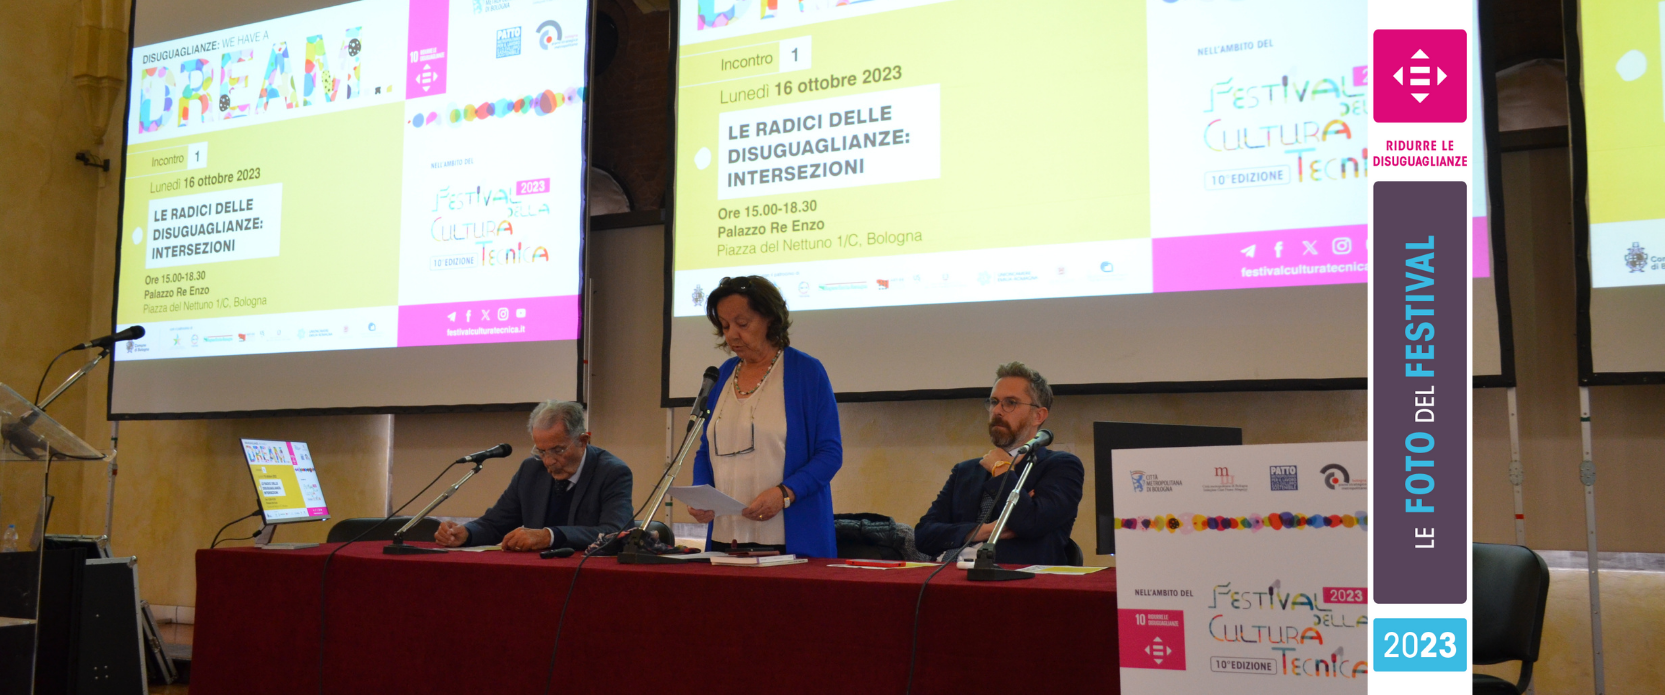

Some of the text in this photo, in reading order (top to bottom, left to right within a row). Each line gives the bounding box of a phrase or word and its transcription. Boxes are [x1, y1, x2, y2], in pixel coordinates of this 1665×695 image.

[497, 28, 520, 40] PATTO
[143, 30, 269, 64] DISUGUAGLIANZE: WE HAVE A
[791, 47, 799, 62] 1
[1197, 39, 1273, 57] NELL'AMBITO DEL
[410, 51, 418, 63] 10
[721, 53, 773, 72] Incontro
[720, 65, 903, 105] Lunedì 16 ottobre 2023
[728, 105, 892, 140] LE RADICI DELLE
[728, 128, 911, 164] DISUGUAGLIANZE:
[151, 154, 185, 167] Incontro
[195, 150, 200, 162] 1
[464, 157, 474, 166] DEL
[184, 176, 195, 189] 16
[197, 172, 234, 187] ottobre
[237, 167, 261, 181] 2023
[727, 158, 865, 188] INTERSEZIONI
[521, 180, 545, 193] 2023
[154, 198, 254, 222] LE RADICI DELLE
[718, 199, 818, 220] Ore 15.00-18.30
[153, 217, 263, 241] DISUGUAGLIANZE:
[718, 218, 825, 239] Palazzo Re Enzo
[152, 239, 235, 260] INTERSEZIONI
[717, 230, 923, 257] Piazza del Nettuno 1/C, Bologna
[145, 270, 206, 285] Ore 15.00-18.30
[144, 285, 210, 299] Palazzo Re Enzo
[143, 303, 168, 314] Piazza
[169, 302, 181, 312] del
[183, 299, 214, 311] Nettuno
[234, 296, 267, 309] Bologna
[446, 325, 526, 337] festivalculturatecnica.it
[1270, 466, 1296, 475] PATTO
[1134, 588, 1194, 597] NELL'AMBITO DEL
[1330, 589, 1363, 602] 2023
[1135, 614, 1146, 626] 10
